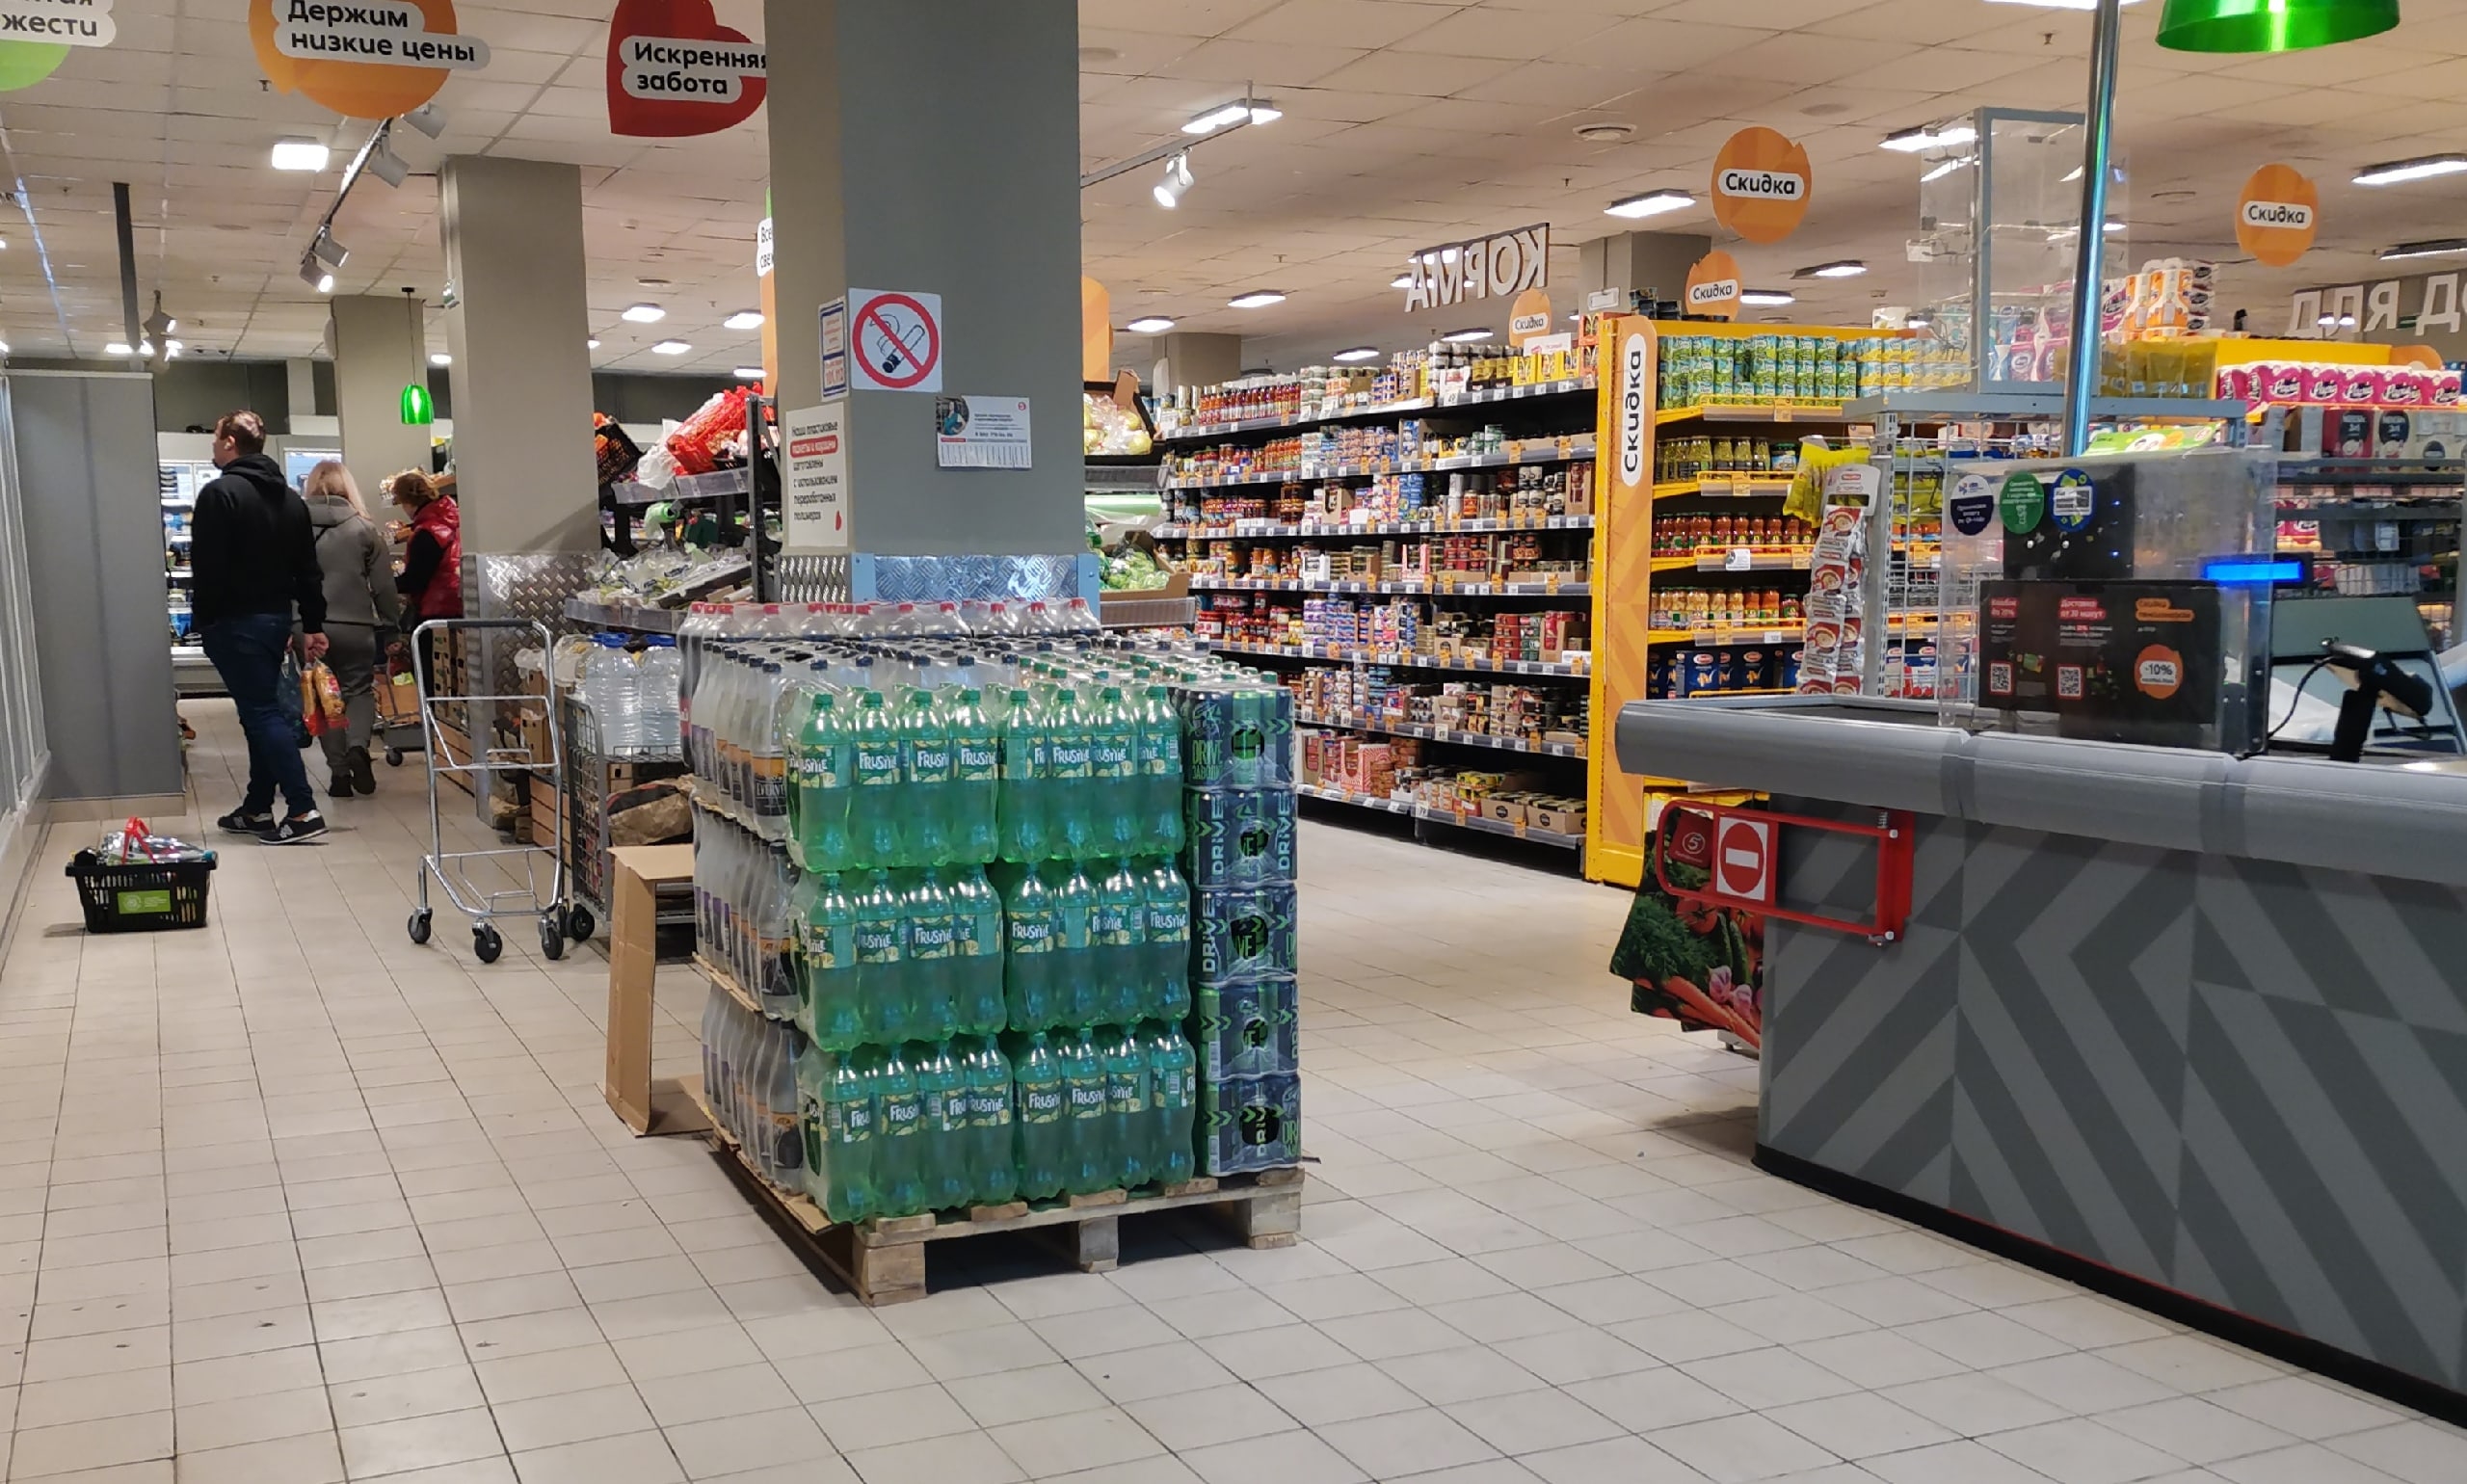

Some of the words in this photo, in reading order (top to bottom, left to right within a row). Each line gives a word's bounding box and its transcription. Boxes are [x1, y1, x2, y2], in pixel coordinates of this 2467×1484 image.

[288, 0, 409, 28] Держим
[291, 32, 393, 56] низкие
[402, 40, 475, 62] цены
[637, 70, 729, 94] забота
[1725, 172, 1797, 196] Скидка
[2248, 204, 2306, 224] Скидка
[1692, 280, 1734, 303] Скидка
[2285, 279, 2401, 339] ДЛЯ
[2415, 273, 2467, 336] Д
[1515, 316, 1545, 331] Скидка
[1624, 351, 1641, 472] Скидка
[2144, 663, 2173, 676] -10%
[1211, 794, 1225, 876] DRIVE
[1278, 791, 1291, 871] DRIVE
[1202, 892, 1216, 973] DRIVE
